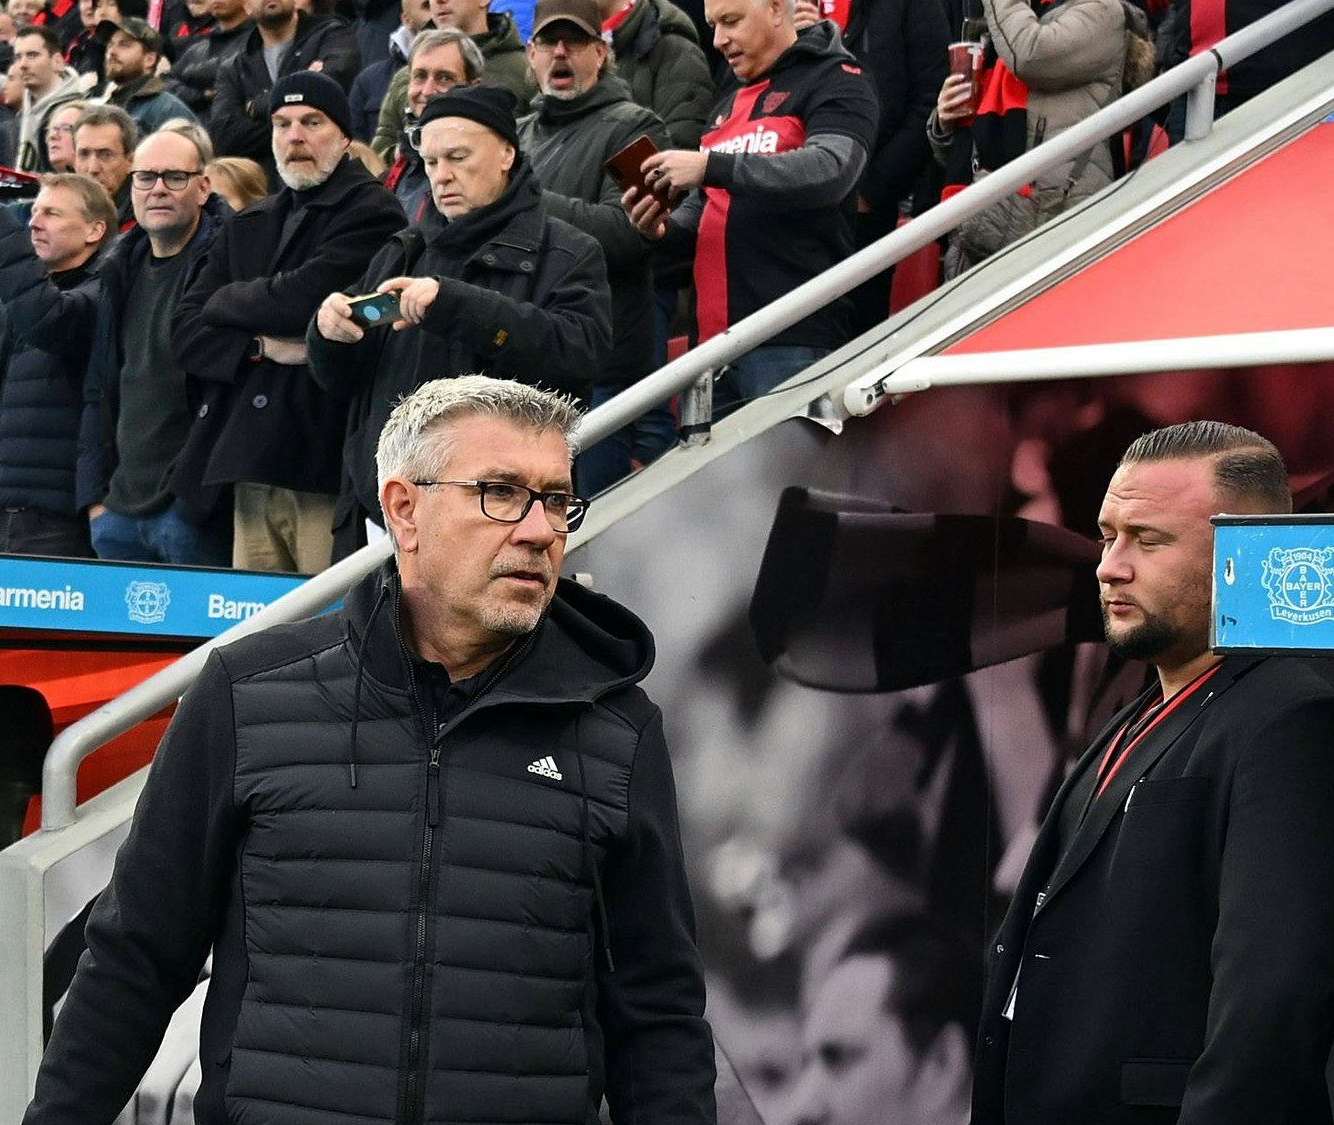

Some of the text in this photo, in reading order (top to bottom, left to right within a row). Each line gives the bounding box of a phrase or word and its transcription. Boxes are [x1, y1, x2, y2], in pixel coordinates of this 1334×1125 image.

[1293, 552, 1313, 560] 1904
[1286, 582, 1321, 591] BAYER
[208, 594, 267, 620] Barm
[1276, 607, 1332, 622] Leverkusen
[527, 764, 563, 781] adidas
